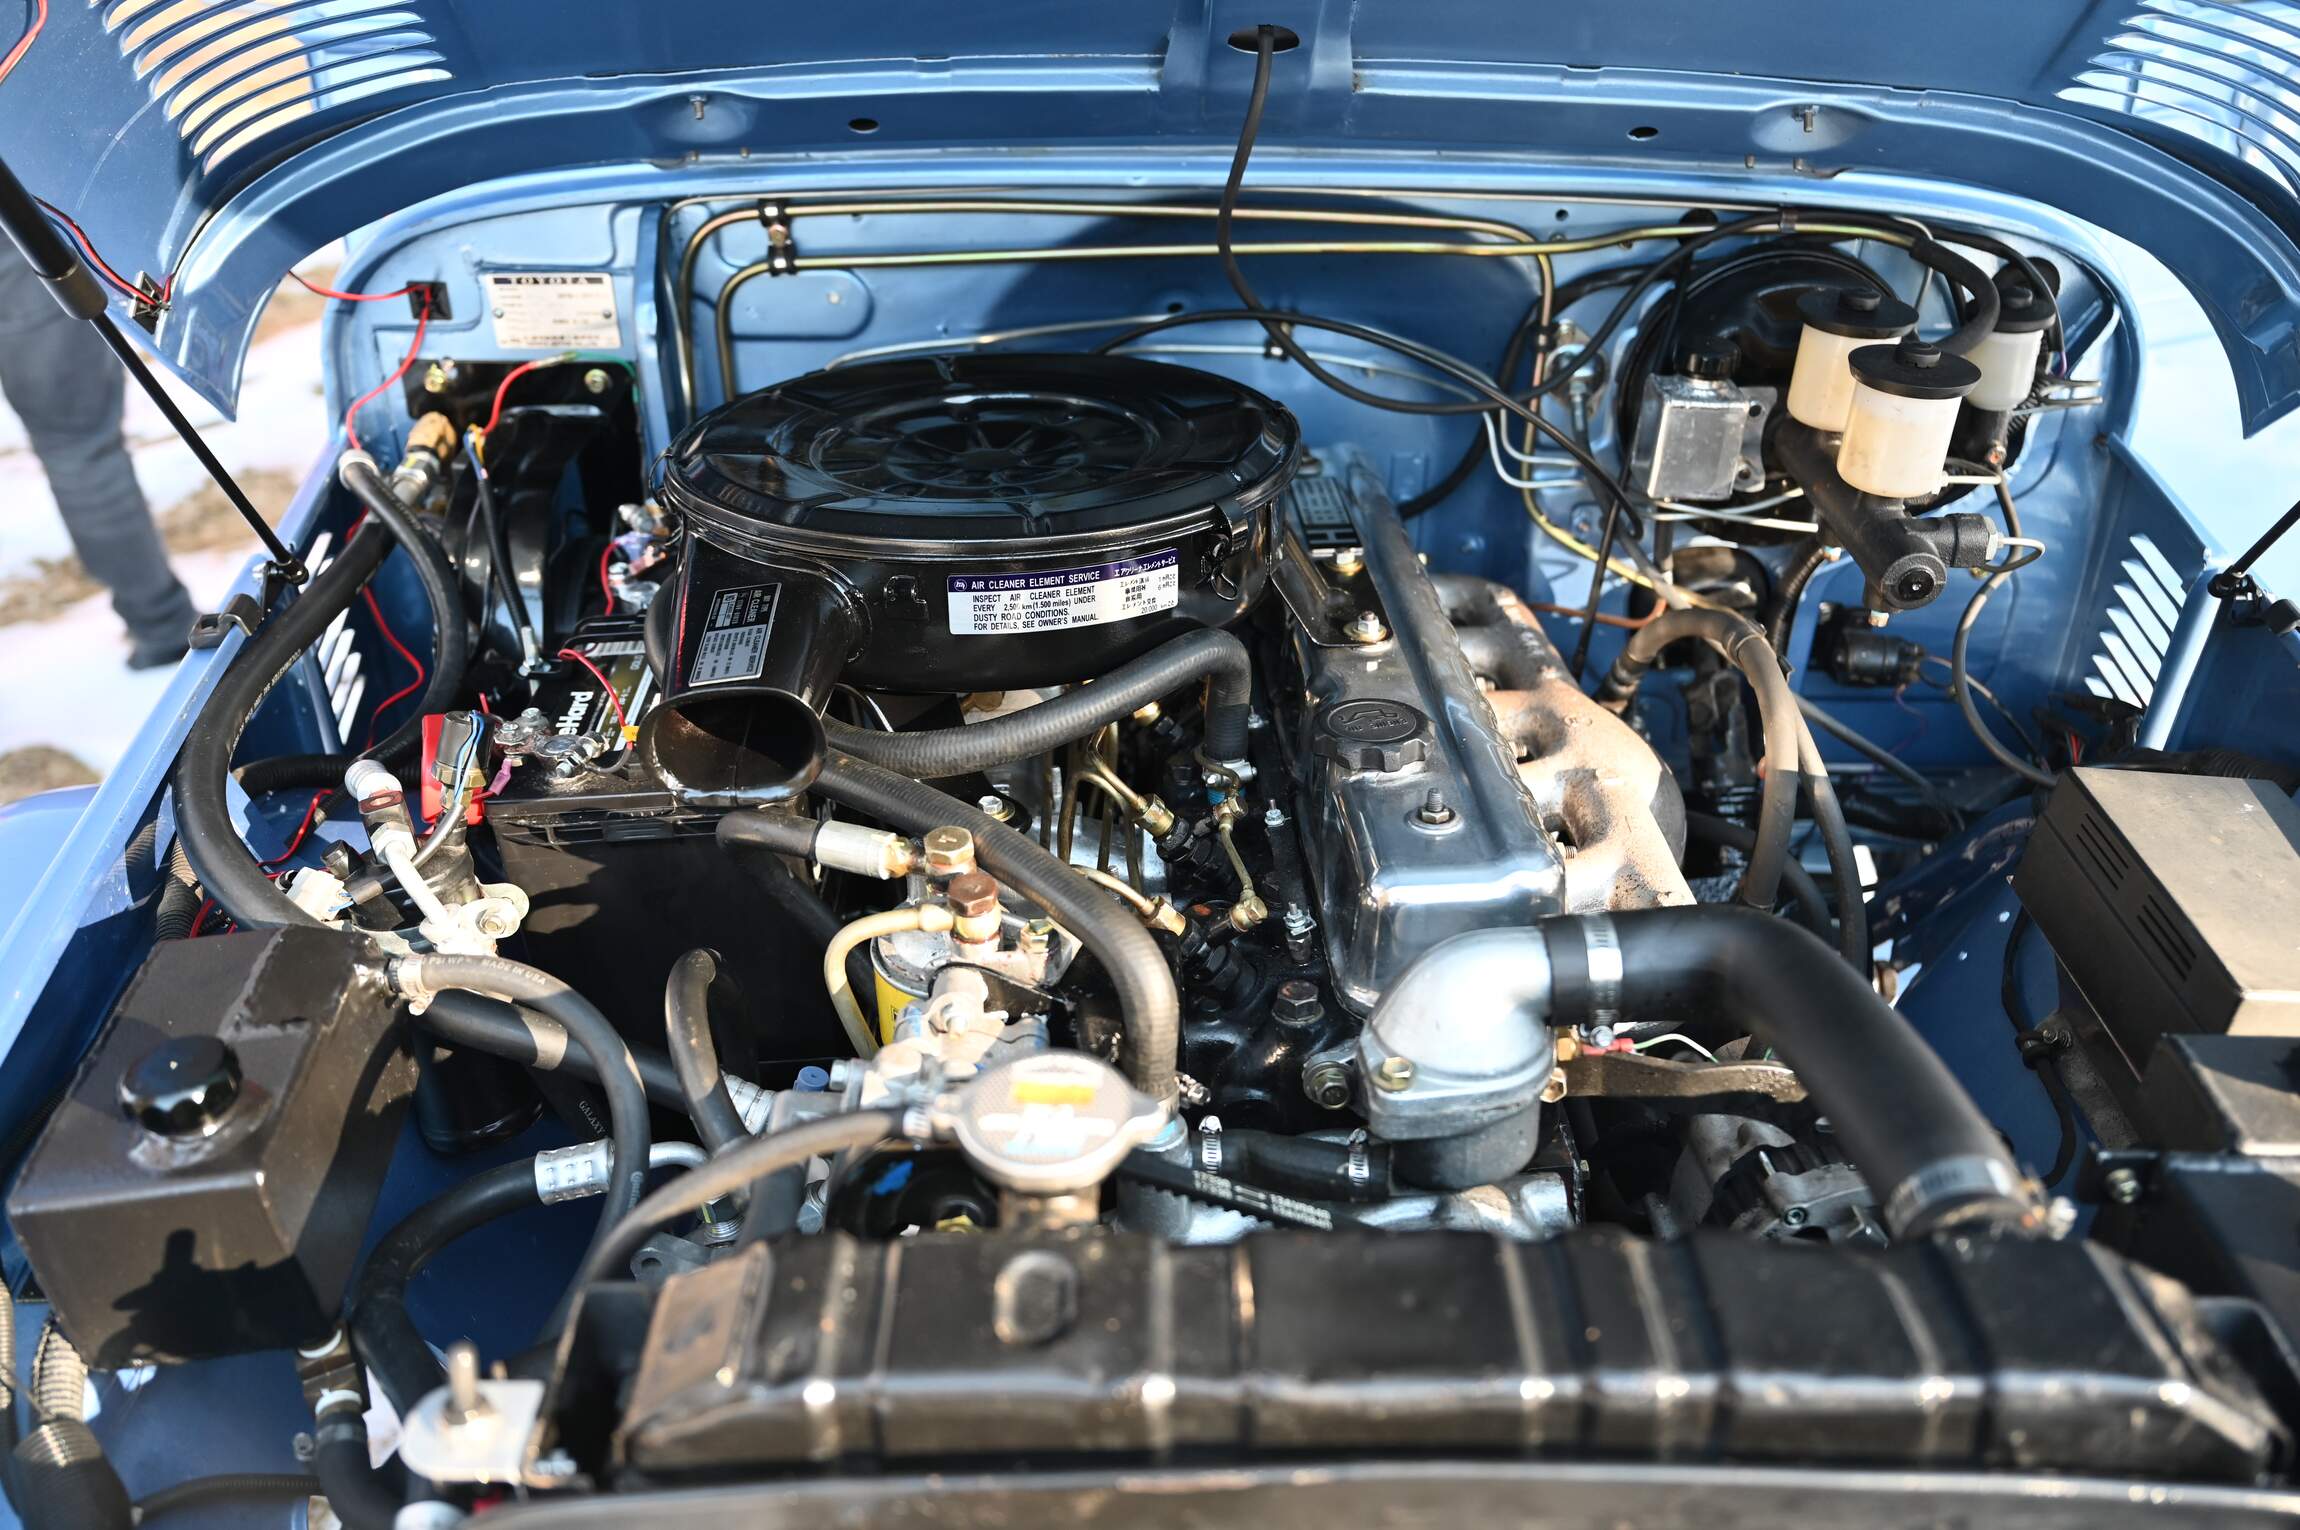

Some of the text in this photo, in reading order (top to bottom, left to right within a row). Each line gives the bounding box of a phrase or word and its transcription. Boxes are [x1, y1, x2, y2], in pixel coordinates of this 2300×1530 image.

[971, 581, 985, 590] AIR
[988, 579, 1026, 589] CLEANER
[1029, 576, 1065, 587] ELEMENT
[1068, 570, 1100, 584] SERVICE
[972, 585, 1095, 603] INSPECT AIR CLEANER ELEMENT
[973, 604, 996, 612] EVERY
[1073, 595, 1096, 605] UNDER
[973, 613, 998, 622] DUSTY
[1000, 612, 1022, 621] ROAD
[973, 623, 988, 631] FOR
[1022, 620, 1035, 629] SEE
[1038, 617, 1068, 627] OWNER'S
[555, 691, 594, 735] eHard
[481, 959, 512, 971] MADE
[512, 966, 525, 976] IN
[525, 971, 547, 985] USA
[579, 1100, 606, 1134] GALAXY
